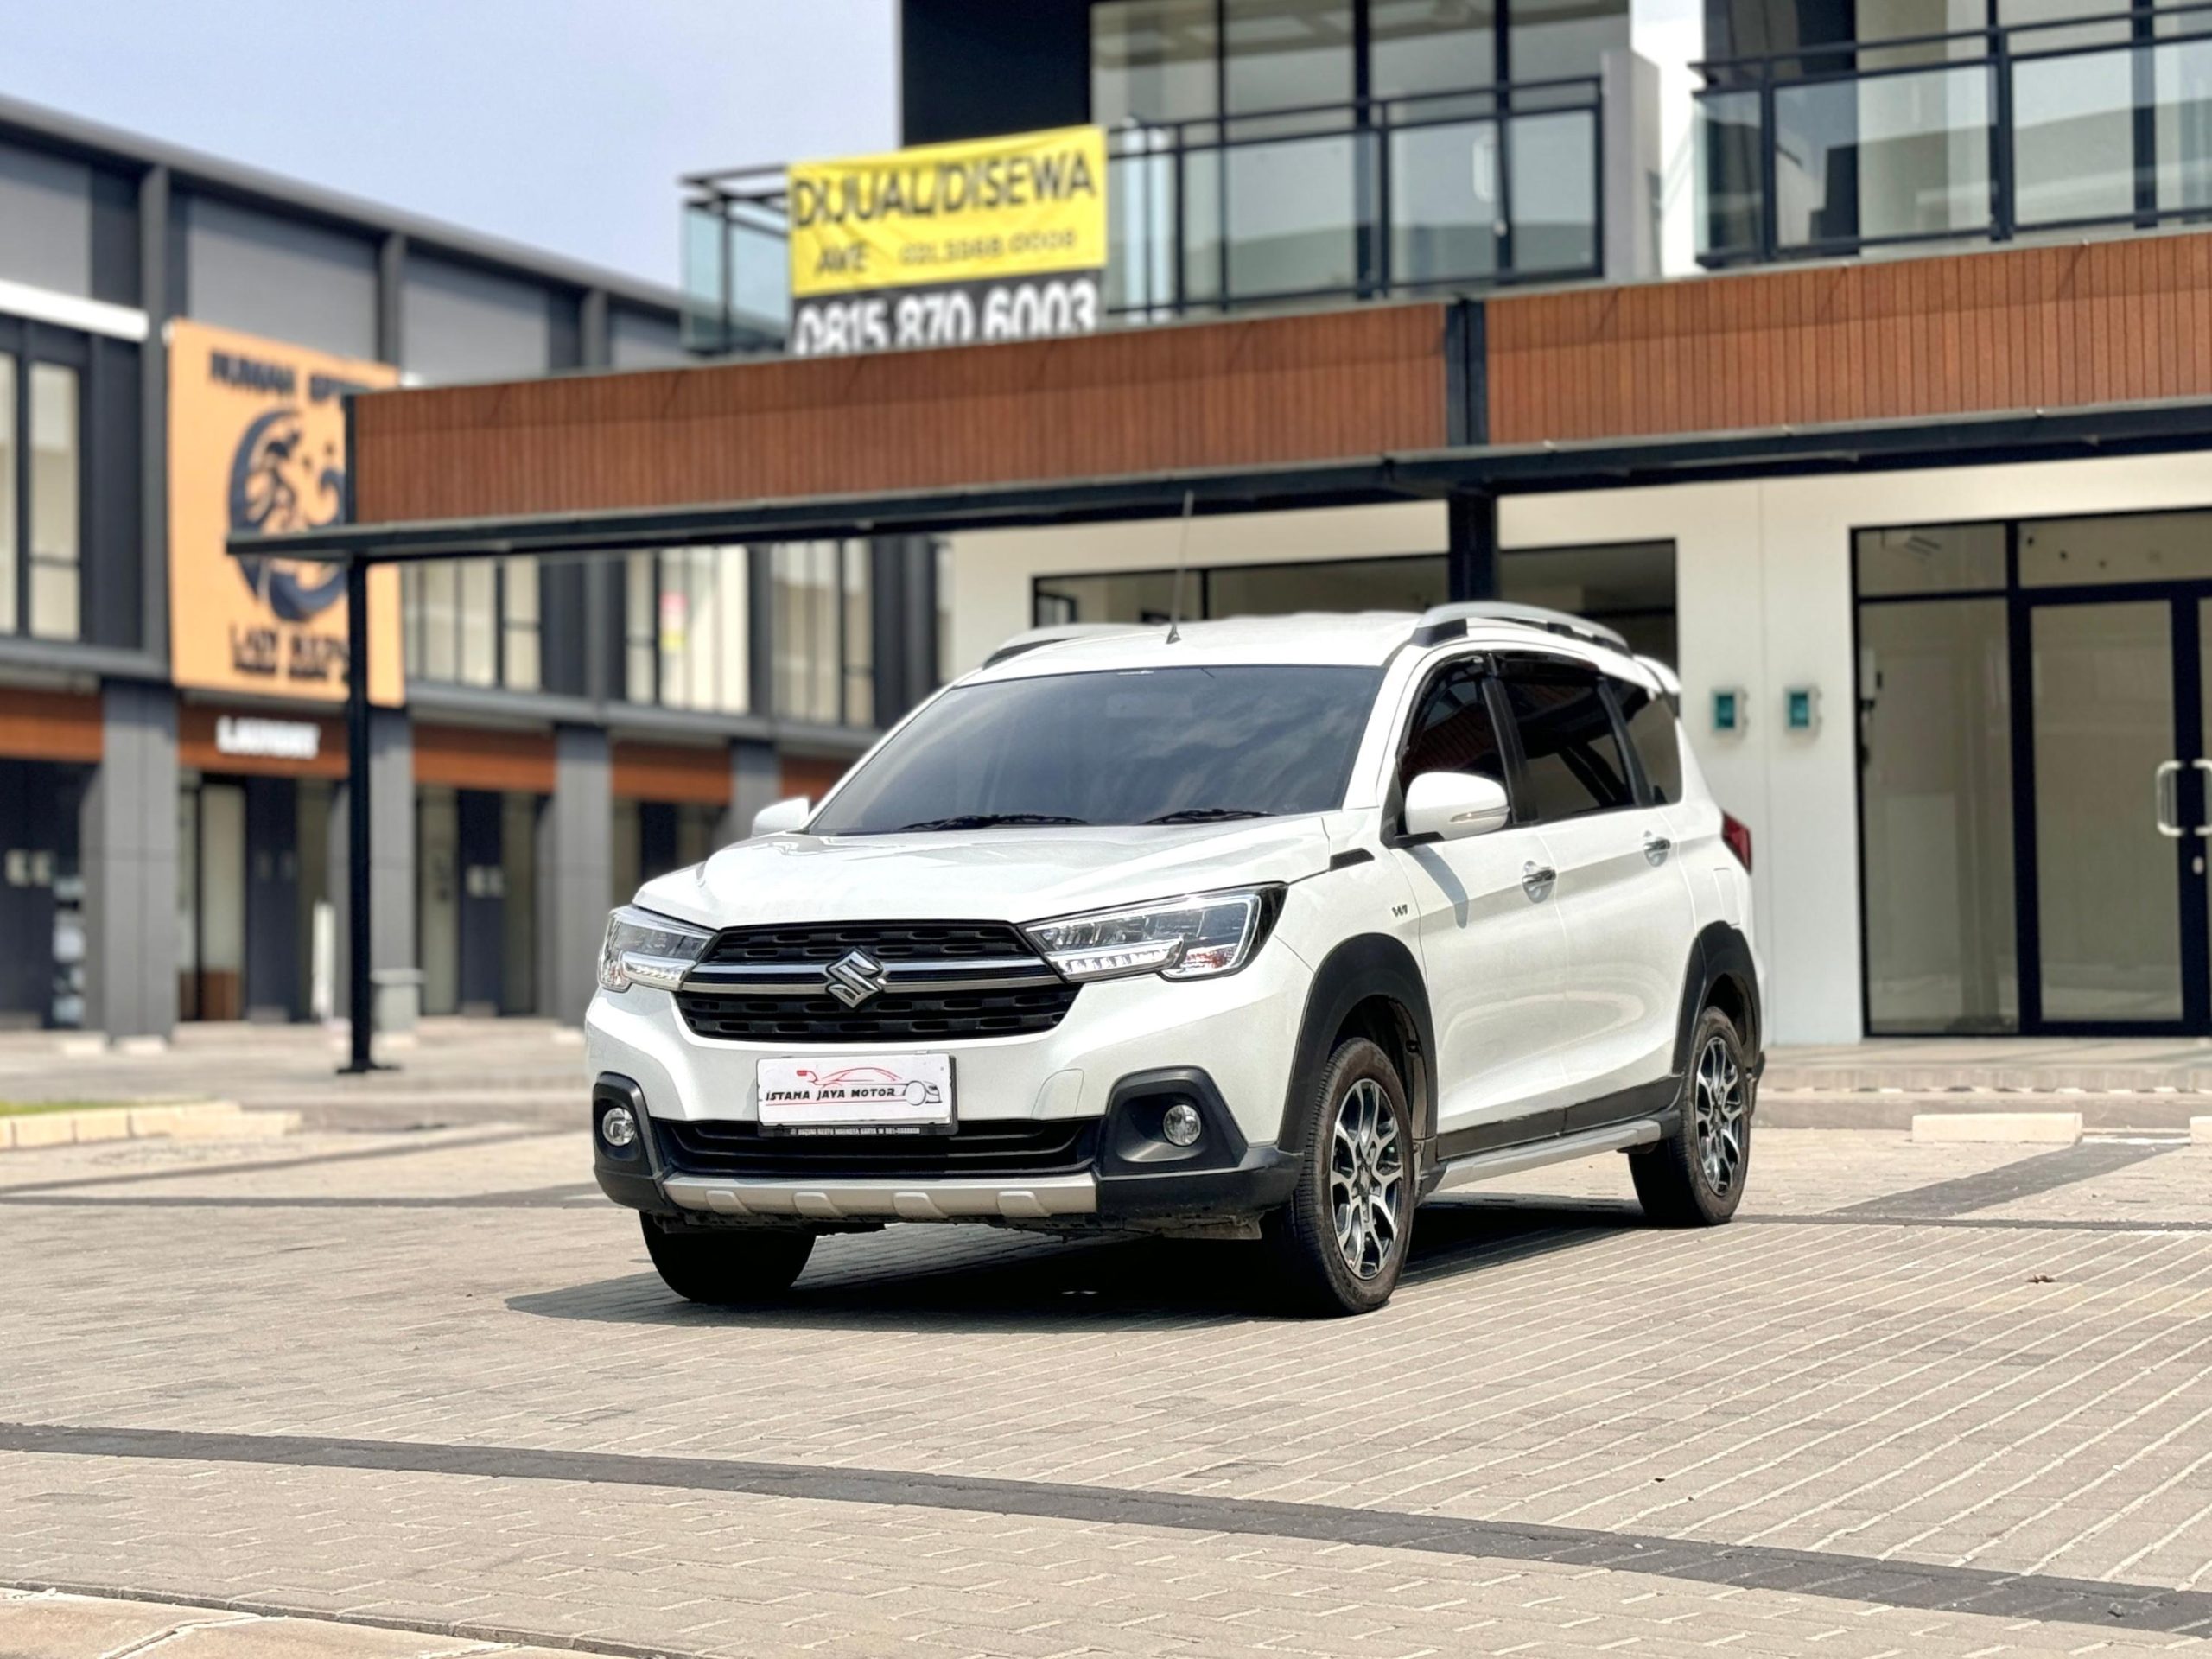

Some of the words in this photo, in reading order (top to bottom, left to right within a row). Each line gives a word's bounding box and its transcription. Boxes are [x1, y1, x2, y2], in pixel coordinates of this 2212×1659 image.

[797, 300, 889, 355] 0815
[896, 291, 974, 346] 870
[984, 280, 1097, 337] 6003
[766, 1090, 810, 1101] ISTANA
[816, 1089, 846, 1101] JAYA
[850, 1087, 896, 1098] MOTOR
